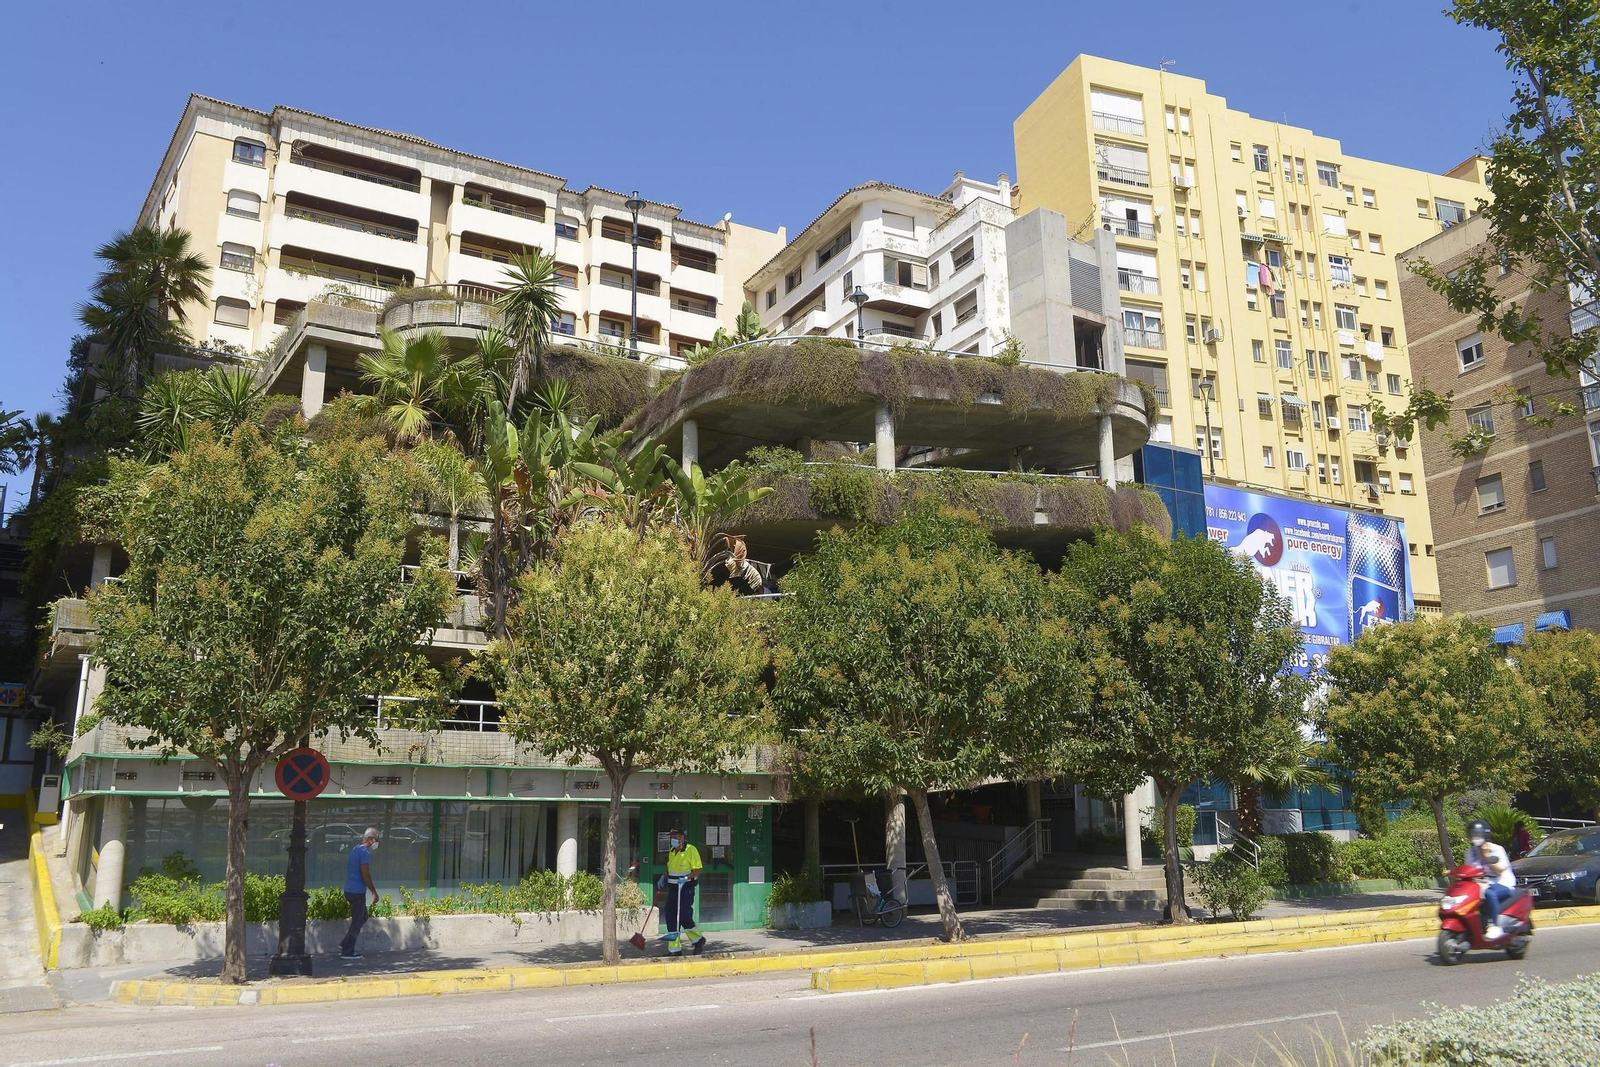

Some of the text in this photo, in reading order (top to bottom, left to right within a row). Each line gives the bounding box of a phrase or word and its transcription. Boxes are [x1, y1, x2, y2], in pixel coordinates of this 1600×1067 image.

[1208, 528, 1227, 540] wer
[1287, 538, 1341, 558] pure energy
[1312, 634, 1341, 646] GIBRALTAR
